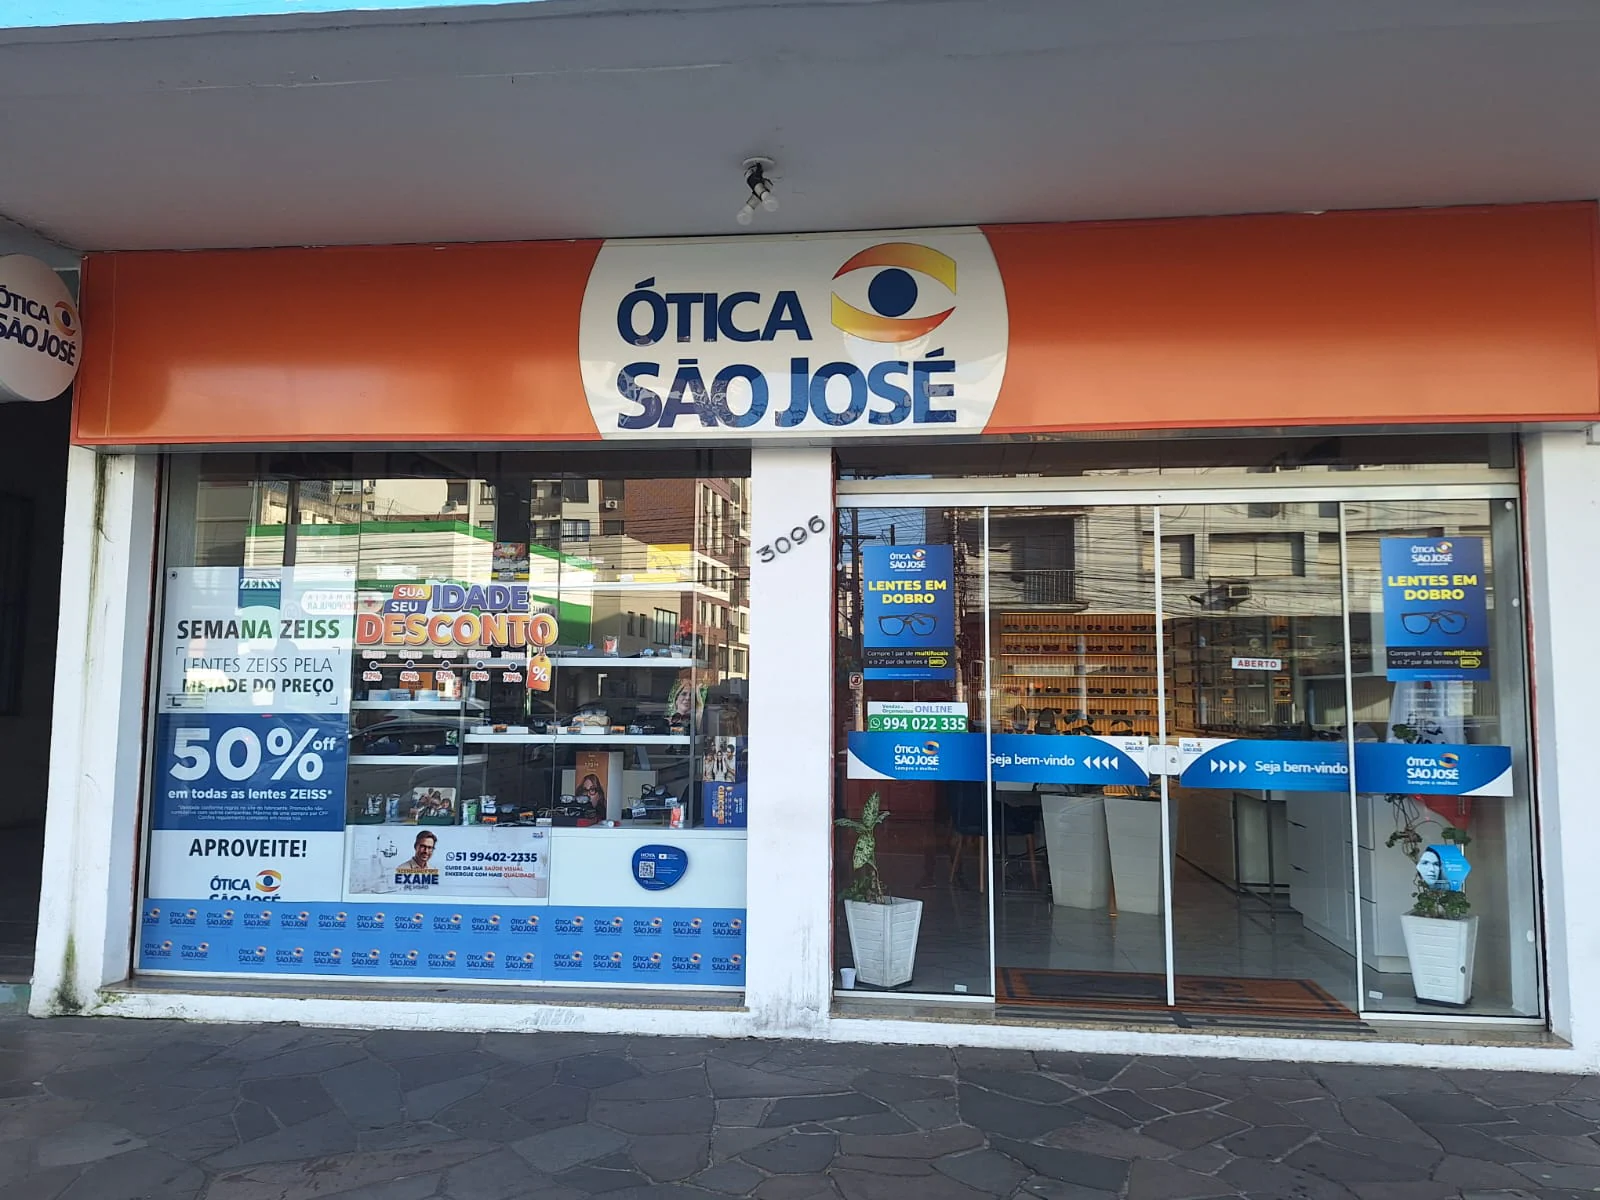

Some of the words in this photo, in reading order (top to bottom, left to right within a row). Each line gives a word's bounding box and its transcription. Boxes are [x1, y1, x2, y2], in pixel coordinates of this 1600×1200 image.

[0, 284, 50, 325] ÓTICA
[617, 277, 813, 347] ÓTICA
[37, 330, 77, 367] JOSÉ
[617, 358, 769, 429] SÃO
[775, 347, 957, 428] JOSÉ
[756, 515, 826, 563] 3096
[1411, 545, 1435, 553] ÓTICA
[889, 552, 911, 560] ÓTICA
[868, 580, 922, 591] LENTES
[925, 580, 947, 591] EM
[1388, 575, 1449, 587] LENTES
[1452, 574, 1477, 586] EM
[398, 587, 426, 597] SUA
[432, 584, 529, 611] IDADE
[882, 593, 935, 604] DOBRO
[1404, 589, 1464, 601] DOBRO
[391, 602, 418, 612] SEU
[177, 619, 272, 639] SEMANA
[280, 619, 340, 639] ZEISS
[356, 613, 559, 646] DESCONTO
[183, 657, 240, 673] LENTES
[246, 657, 287, 673] ZEISS
[294, 657, 333, 673] PELA
[1237, 660, 1277, 668] ABERTO
[182, 678, 247, 693] METADE
[253, 678, 276, 693] DO
[281, 678, 334, 697] PREÇO
[915, 705, 953, 713] ONLINE
[883, 717, 908, 730] 994
[911, 717, 937, 730] 022
[941, 718, 966, 730] 335
[169, 727, 324, 781] 50%
[312, 737, 336, 750] off
[894, 744, 920, 754] ÓTICA
[989, 753, 1012, 767] Seja
[1014, 754, 1075, 766] bem-vindo
[1406, 756, 1437, 767] ÓTICA
[1255, 761, 1281, 775] Seja
[1283, 761, 1348, 774] bem-vindo
[1407, 768, 1431, 779] SÃO
[1431, 767, 1459, 780] JOSÉ
[168, 791, 188, 799] em
[192, 789, 227, 799] todas
[231, 791, 245, 799] as
[249, 789, 286, 799] lentes
[189, 838, 307, 858] APROVEITE!
[455, 852, 467, 861] 51
[470, 852, 538, 862] 99402-2335
[210, 875, 251, 891] ÓTICA
[395, 873, 439, 884] EXAME
